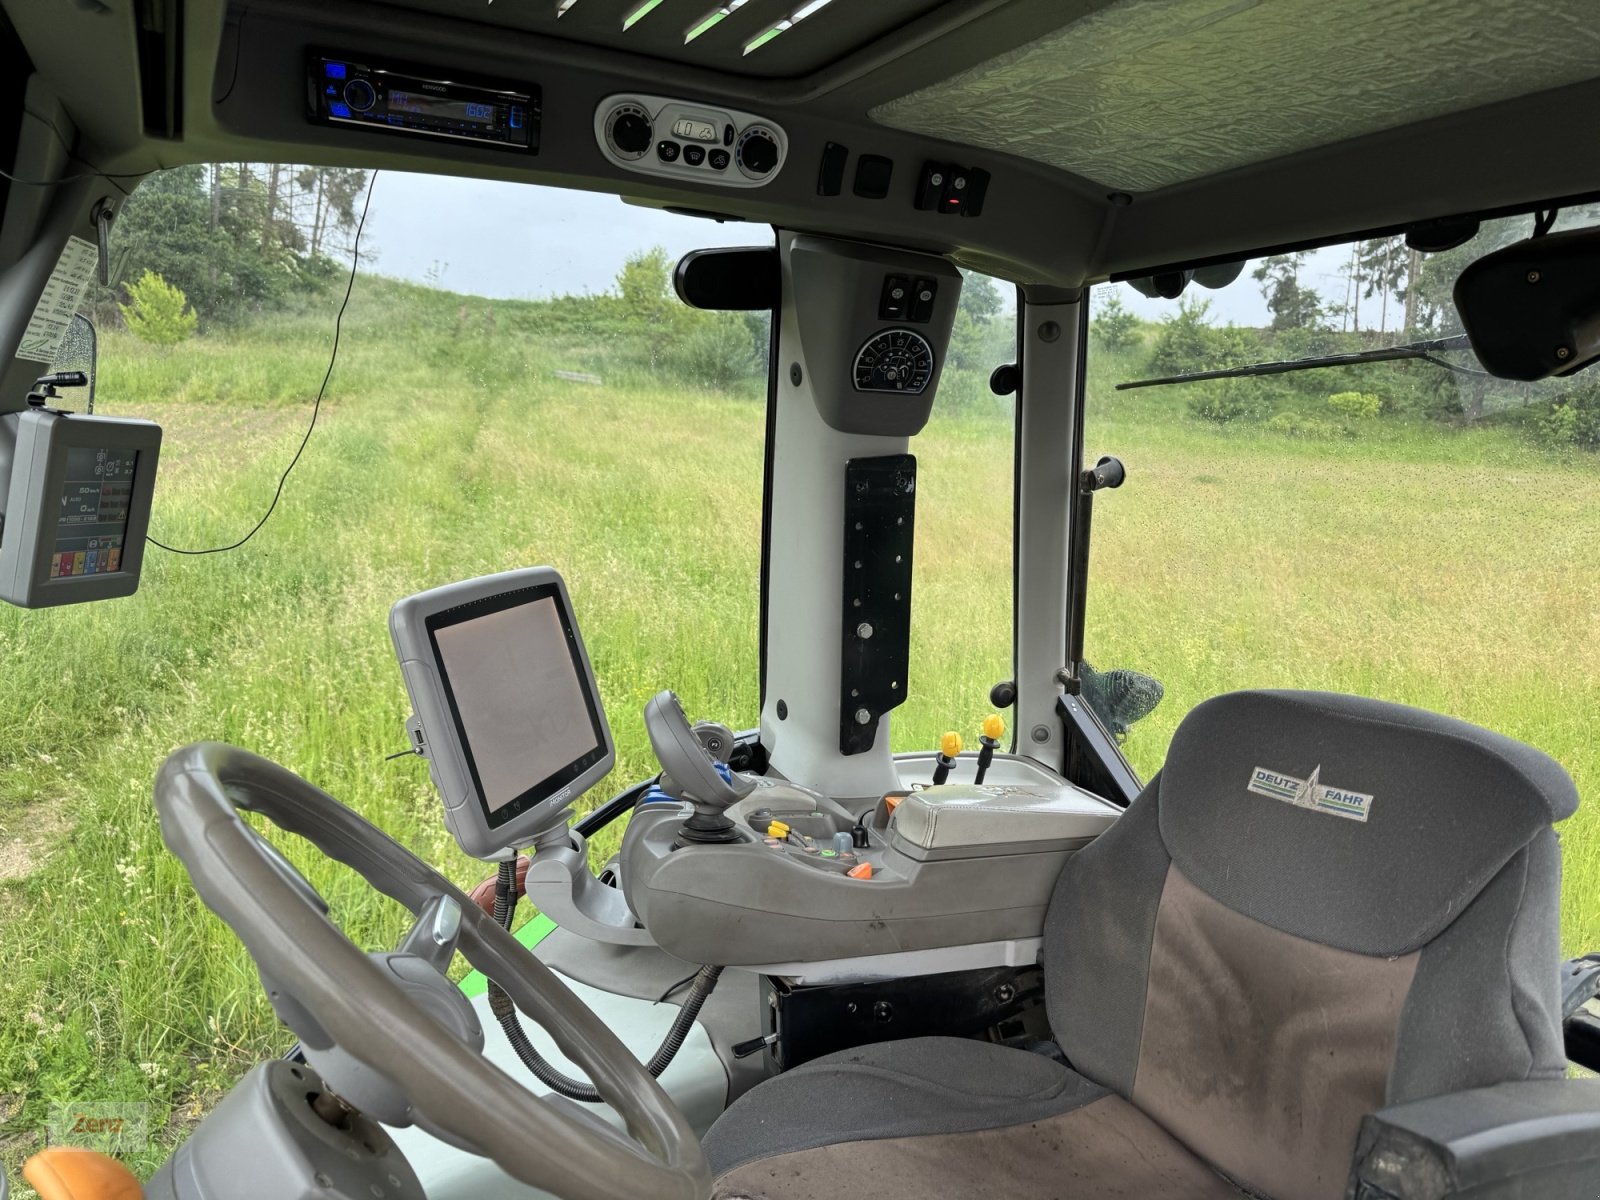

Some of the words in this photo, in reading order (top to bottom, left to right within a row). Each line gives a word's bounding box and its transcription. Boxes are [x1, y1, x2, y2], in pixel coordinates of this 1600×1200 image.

[422, 84, 447, 92] KENWOOD
[1255, 771, 1300, 790] DEUTZ
[1324, 789, 1364, 806] FAHR
